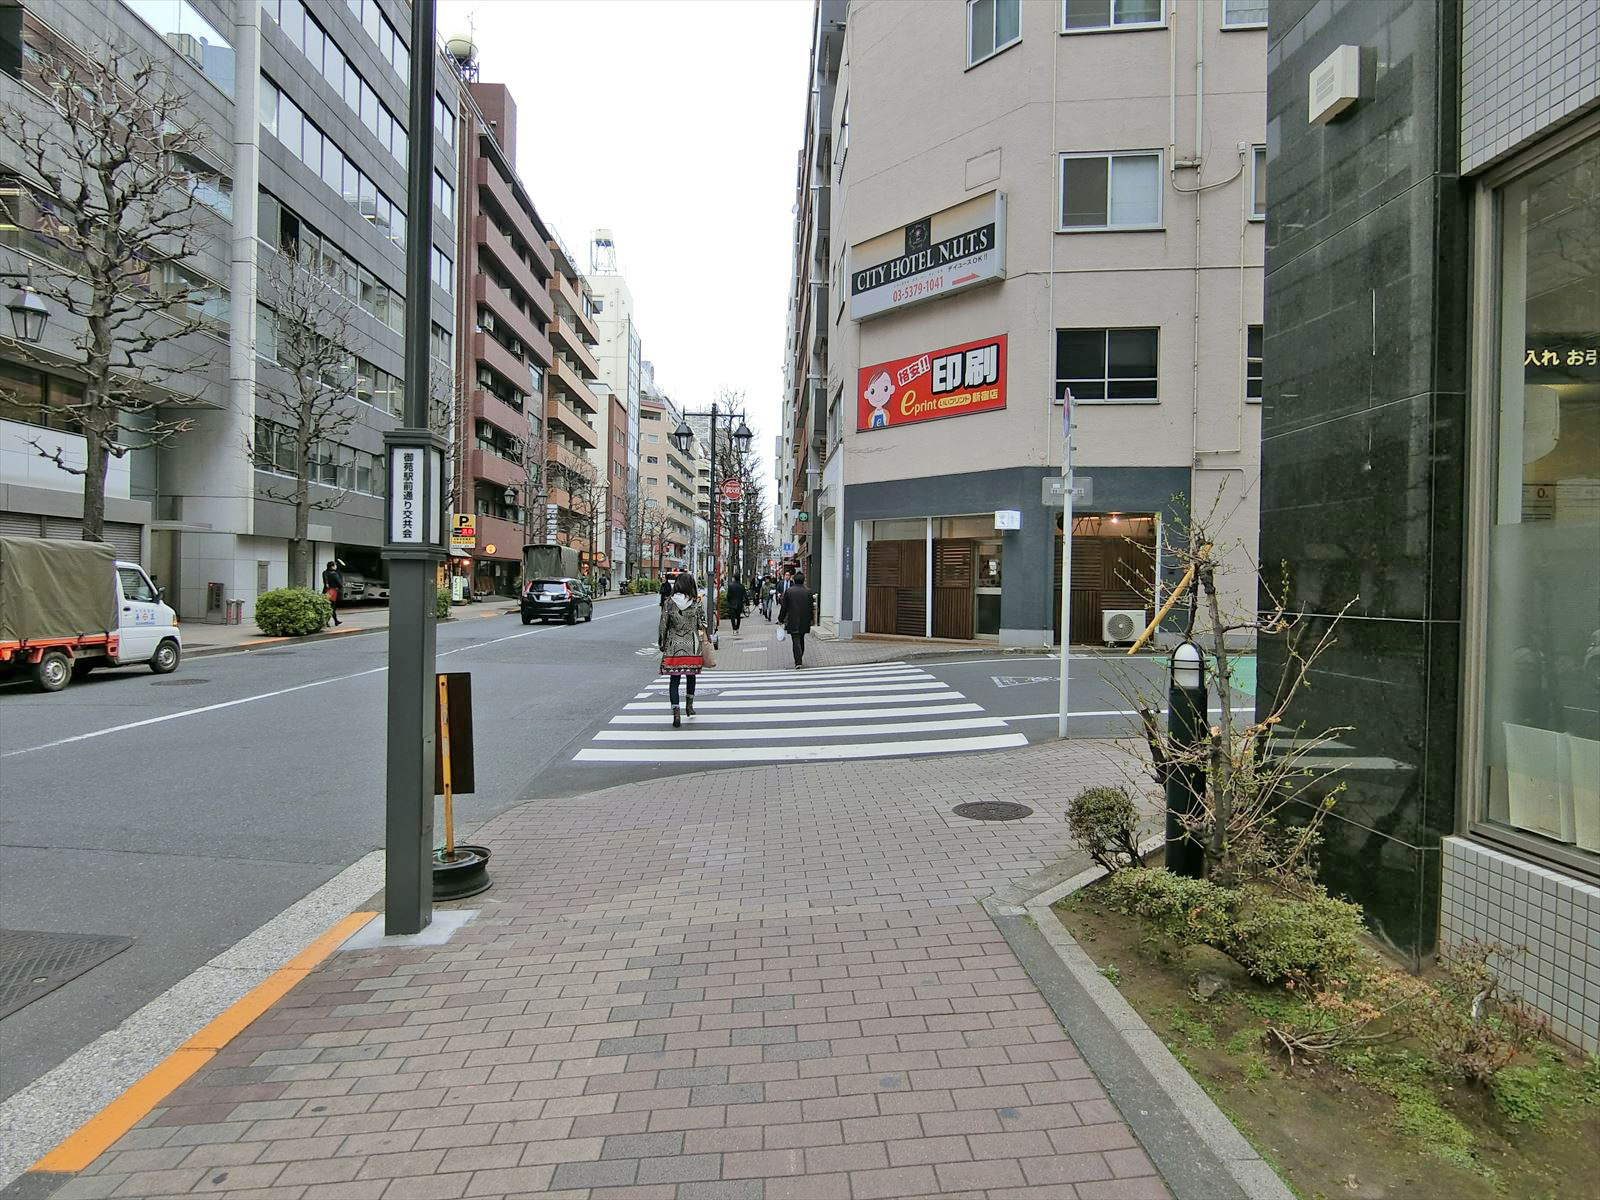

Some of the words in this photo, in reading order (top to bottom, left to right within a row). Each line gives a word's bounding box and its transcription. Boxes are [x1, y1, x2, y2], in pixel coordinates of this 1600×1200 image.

[857, 265, 889, 291] CITY
[890, 249, 935, 280] HOTEL
[892, 275, 944, 302] 03-5379-1041
[932, 344, 998, 393] 印刷
[1524, 349, 1560, 366] 入れ
[901, 390, 937, 416] eprint
[403, 453, 414, 538] 御苑駅前通り交共会
[459, 516, 469, 527] P
